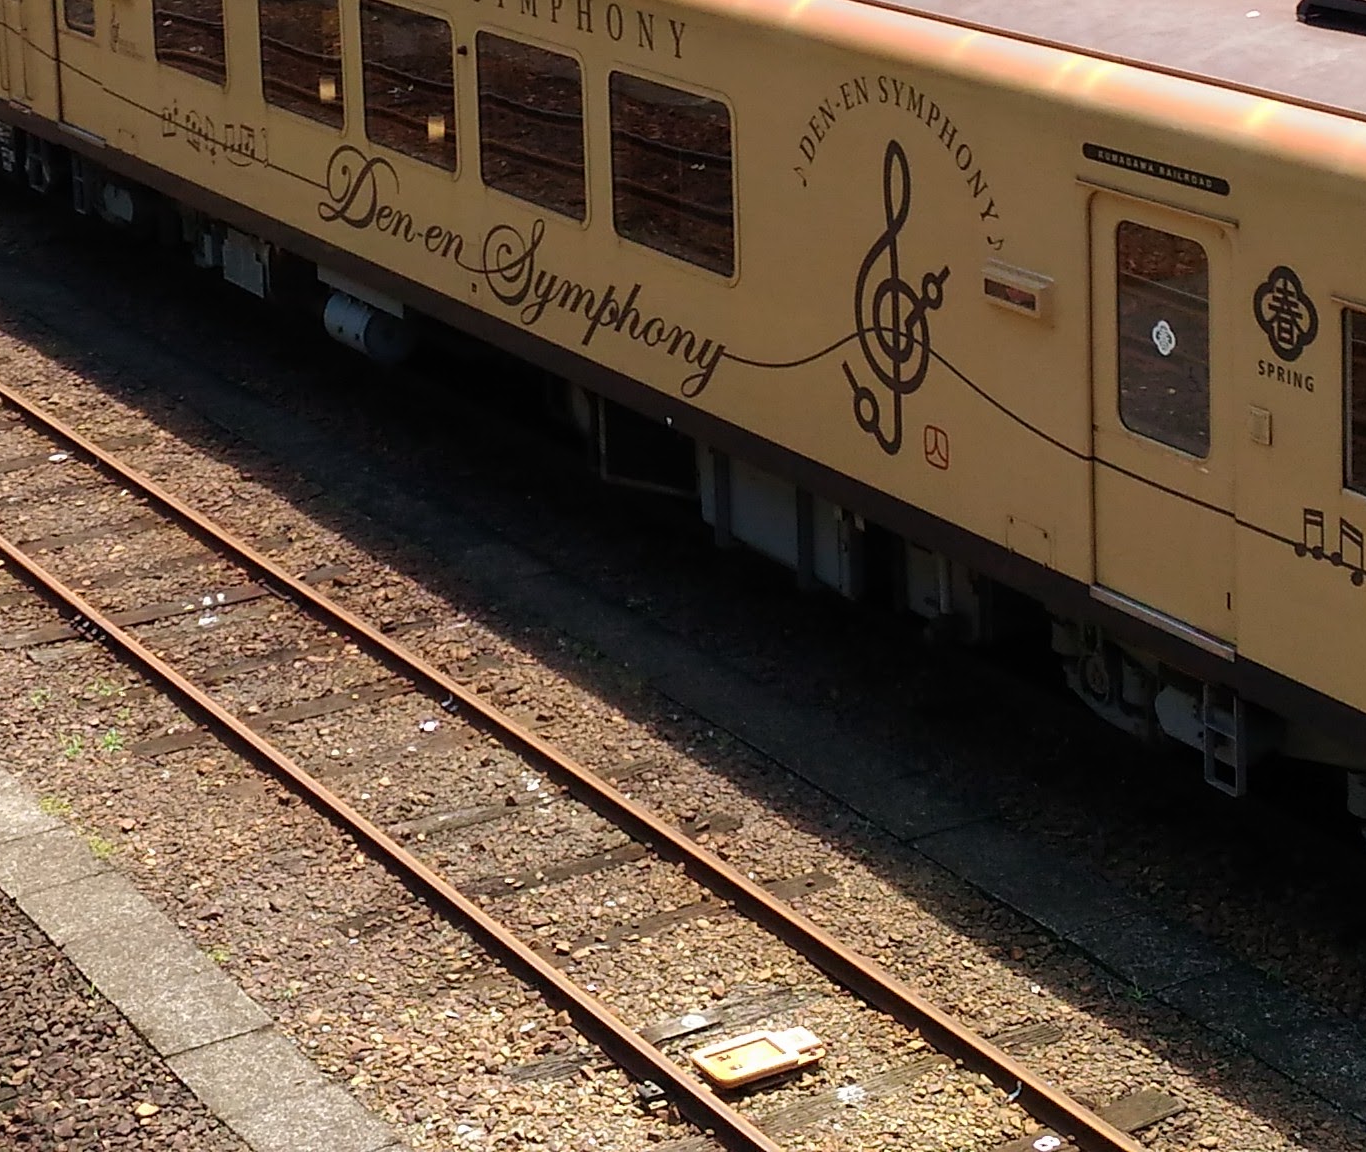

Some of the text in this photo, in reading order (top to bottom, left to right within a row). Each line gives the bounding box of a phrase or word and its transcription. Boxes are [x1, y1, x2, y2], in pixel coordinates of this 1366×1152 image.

[798, 75, 1000, 222] DEN-EN SYMPHONY
[1097, 149, 1213, 189] KUMAGAWA RAILROAD
[317, 144, 727, 399] Den-en Symphony
[1267, 278, 1304, 347] 春
[1257, 360, 1315, 393] SPRING
